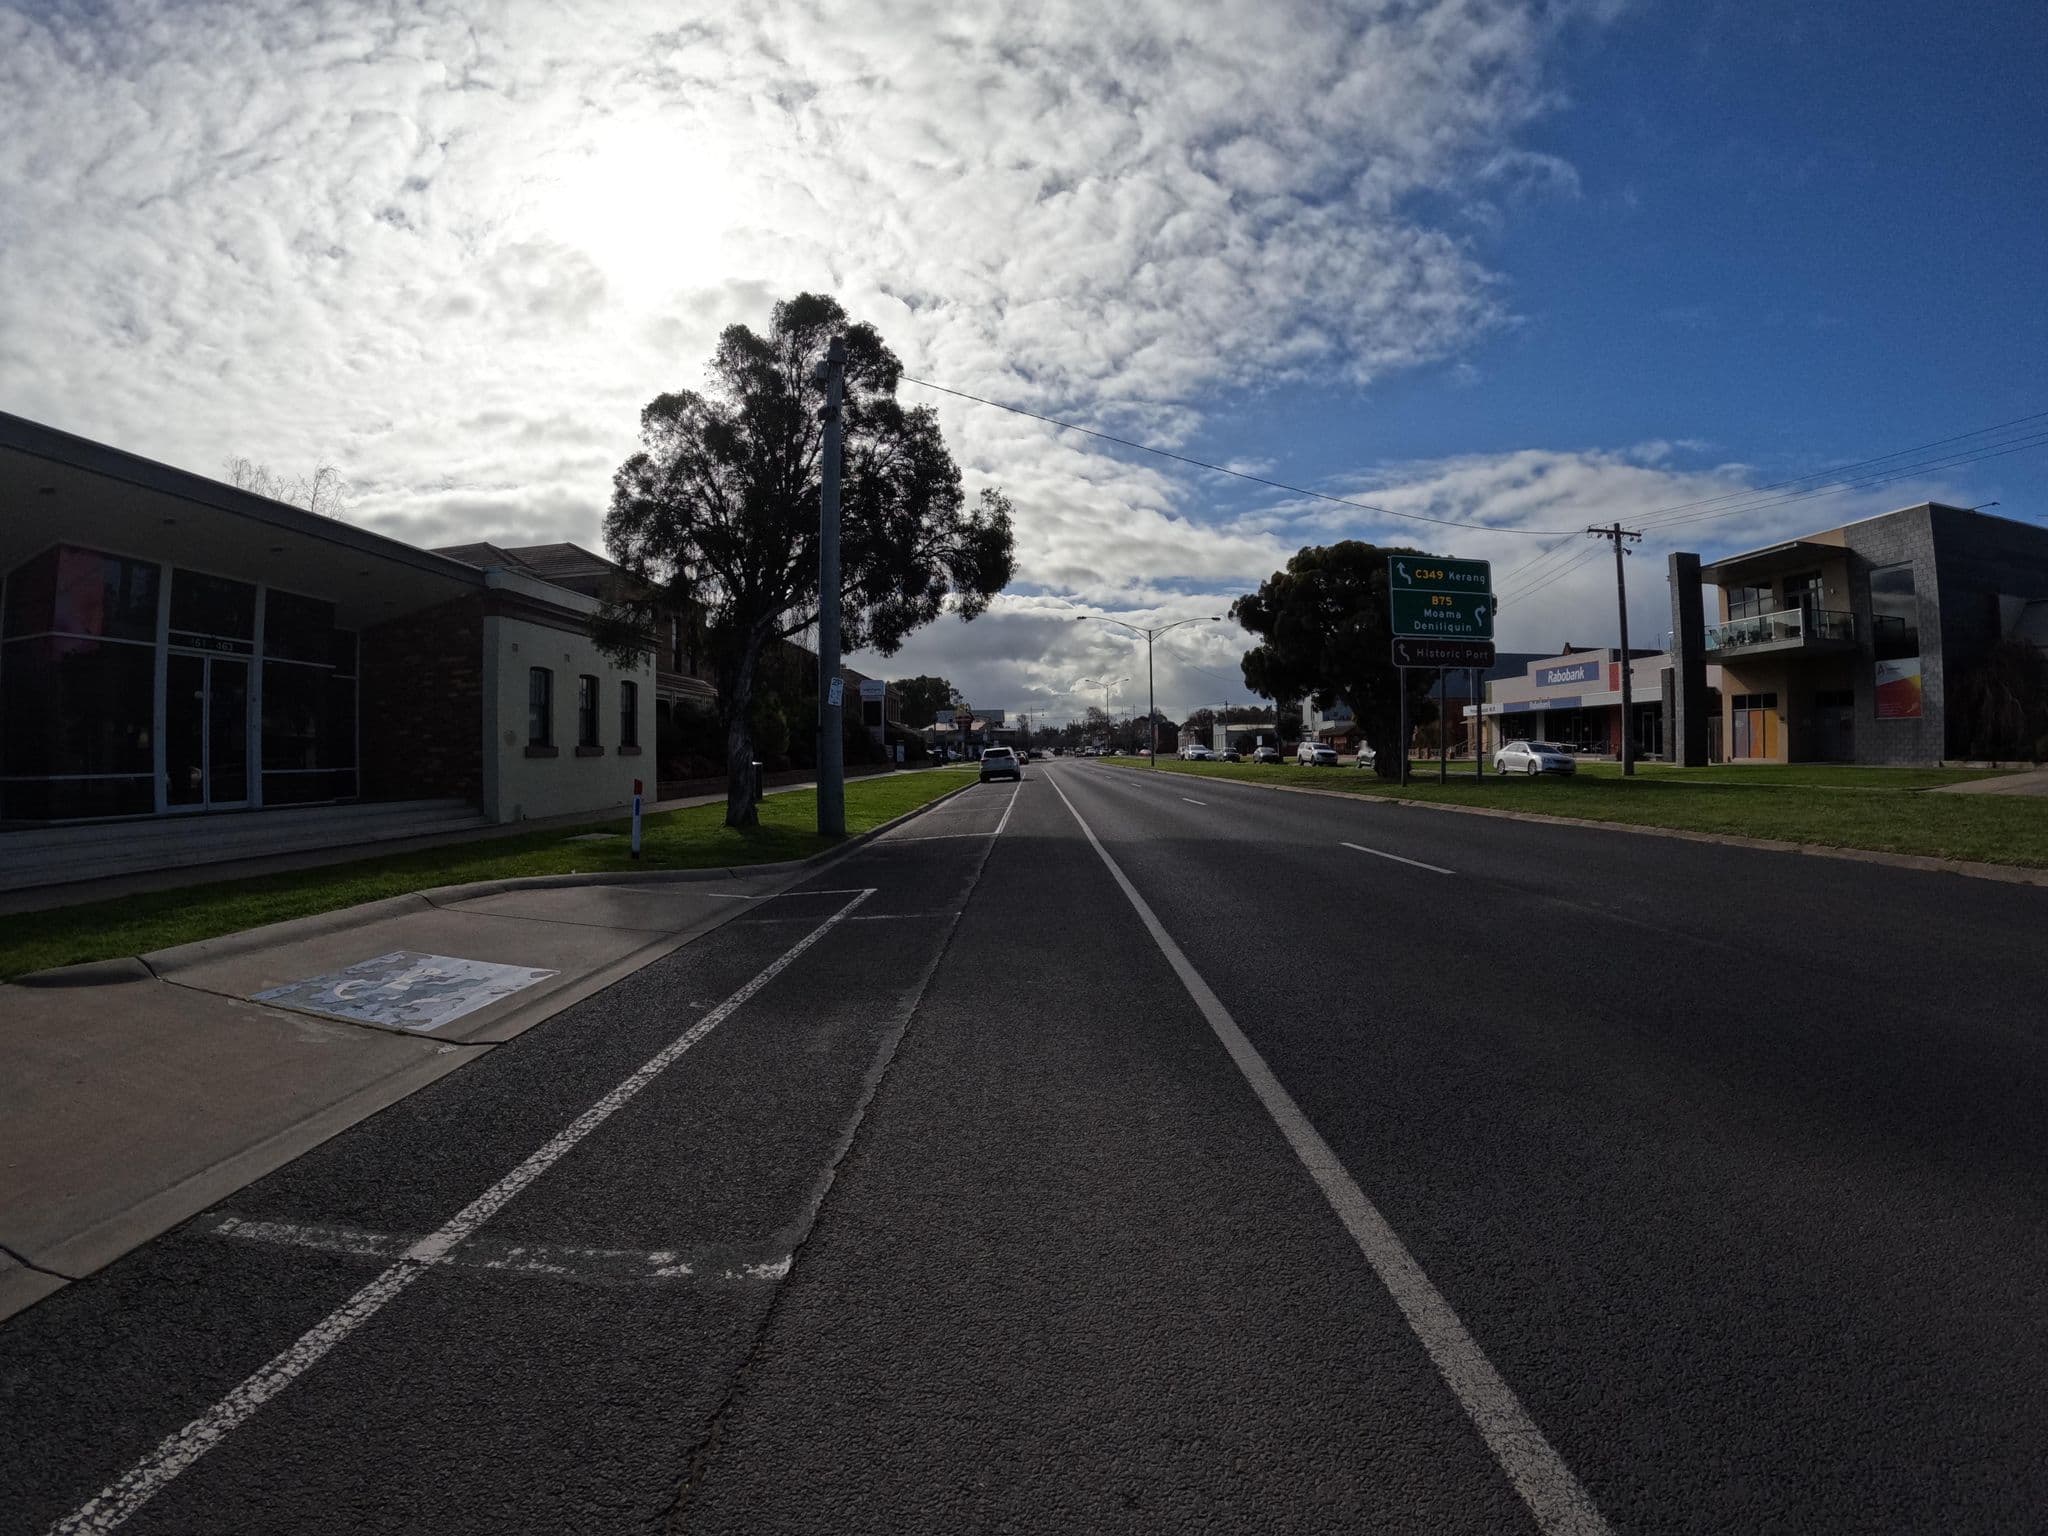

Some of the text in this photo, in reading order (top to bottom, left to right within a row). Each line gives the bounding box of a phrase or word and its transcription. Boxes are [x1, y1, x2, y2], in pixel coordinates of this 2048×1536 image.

[1415, 569, 1486, 585] C349 Kerang
[1431, 595, 1453, 606] B75
[1423, 608, 1462, 619] Moama
[1414, 620, 1472, 633] Deniliquin
[1416, 648, 1488, 660] Historic Port
[1547, 666, 1585, 683] Rabobank
